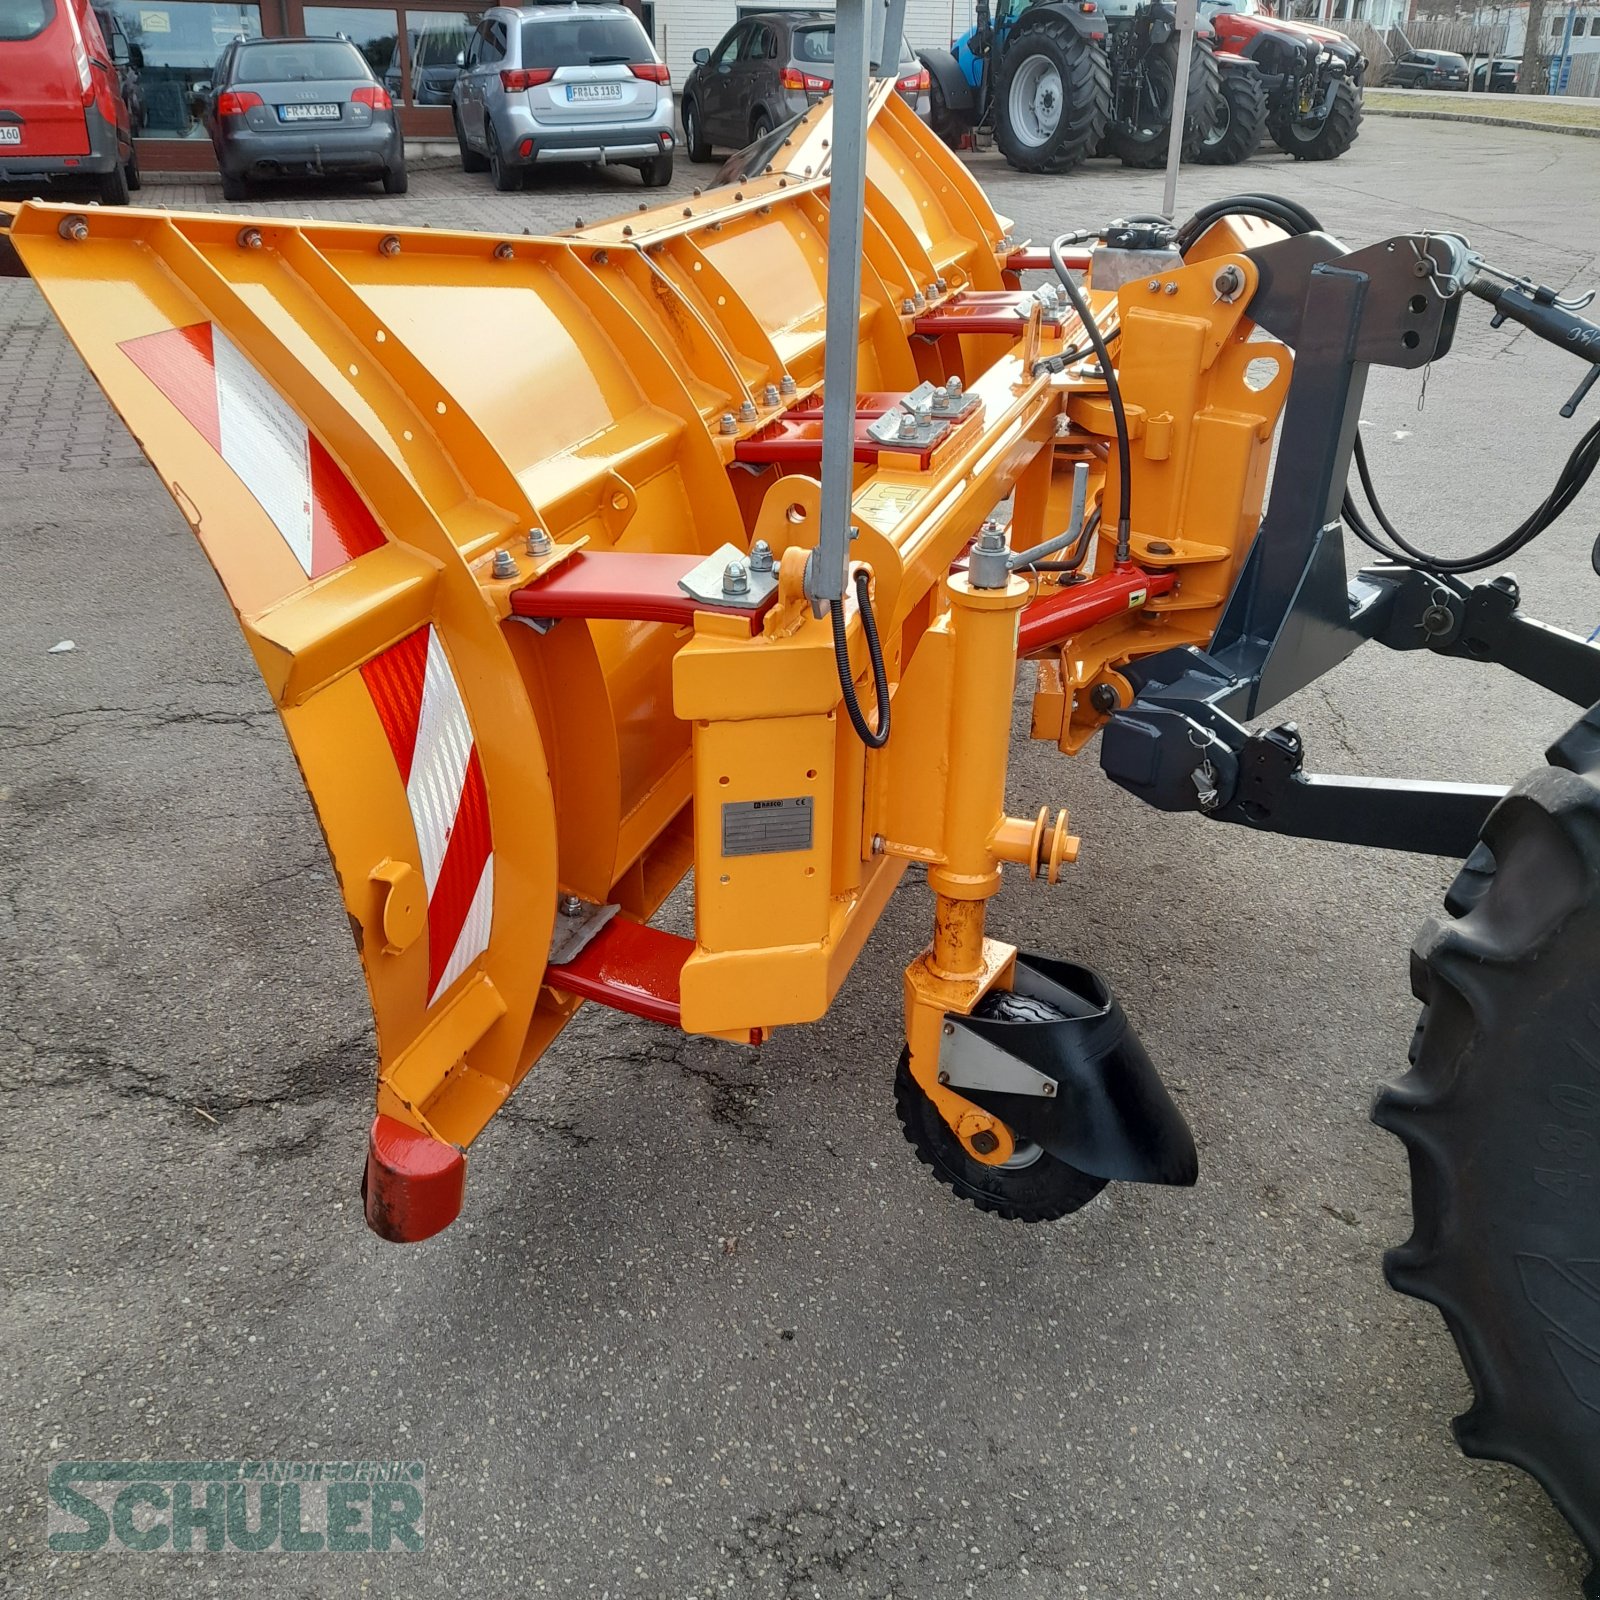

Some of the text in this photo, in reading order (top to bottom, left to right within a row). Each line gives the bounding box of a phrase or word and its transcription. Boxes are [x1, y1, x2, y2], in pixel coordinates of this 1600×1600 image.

[573, 85, 620, 97] FR LS 1183
[286, 105, 337, 116] FR X 1282
